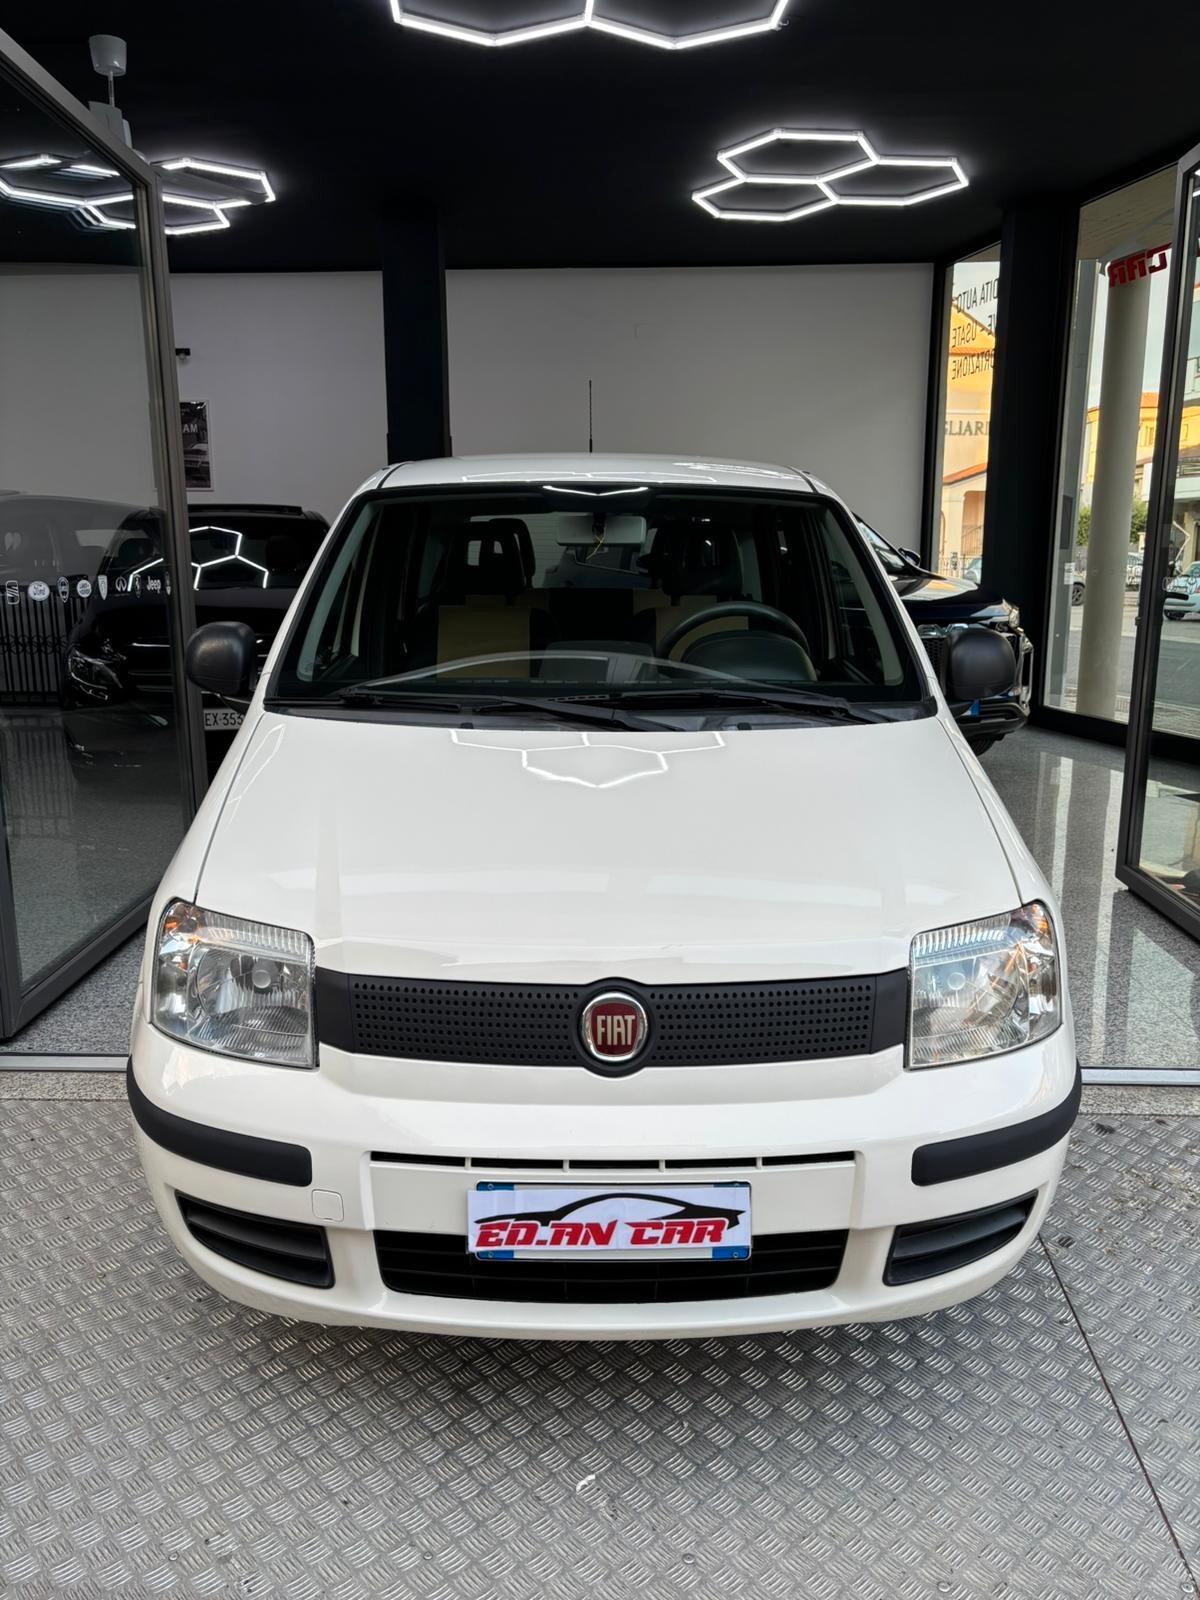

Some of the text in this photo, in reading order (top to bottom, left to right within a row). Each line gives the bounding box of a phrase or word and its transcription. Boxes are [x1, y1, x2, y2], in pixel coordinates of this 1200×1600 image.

[147, 575, 161, 594] Jeep
[596, 1015, 636, 1046] FIAT
[475, 1217, 729, 1248] ED.AN CAR
